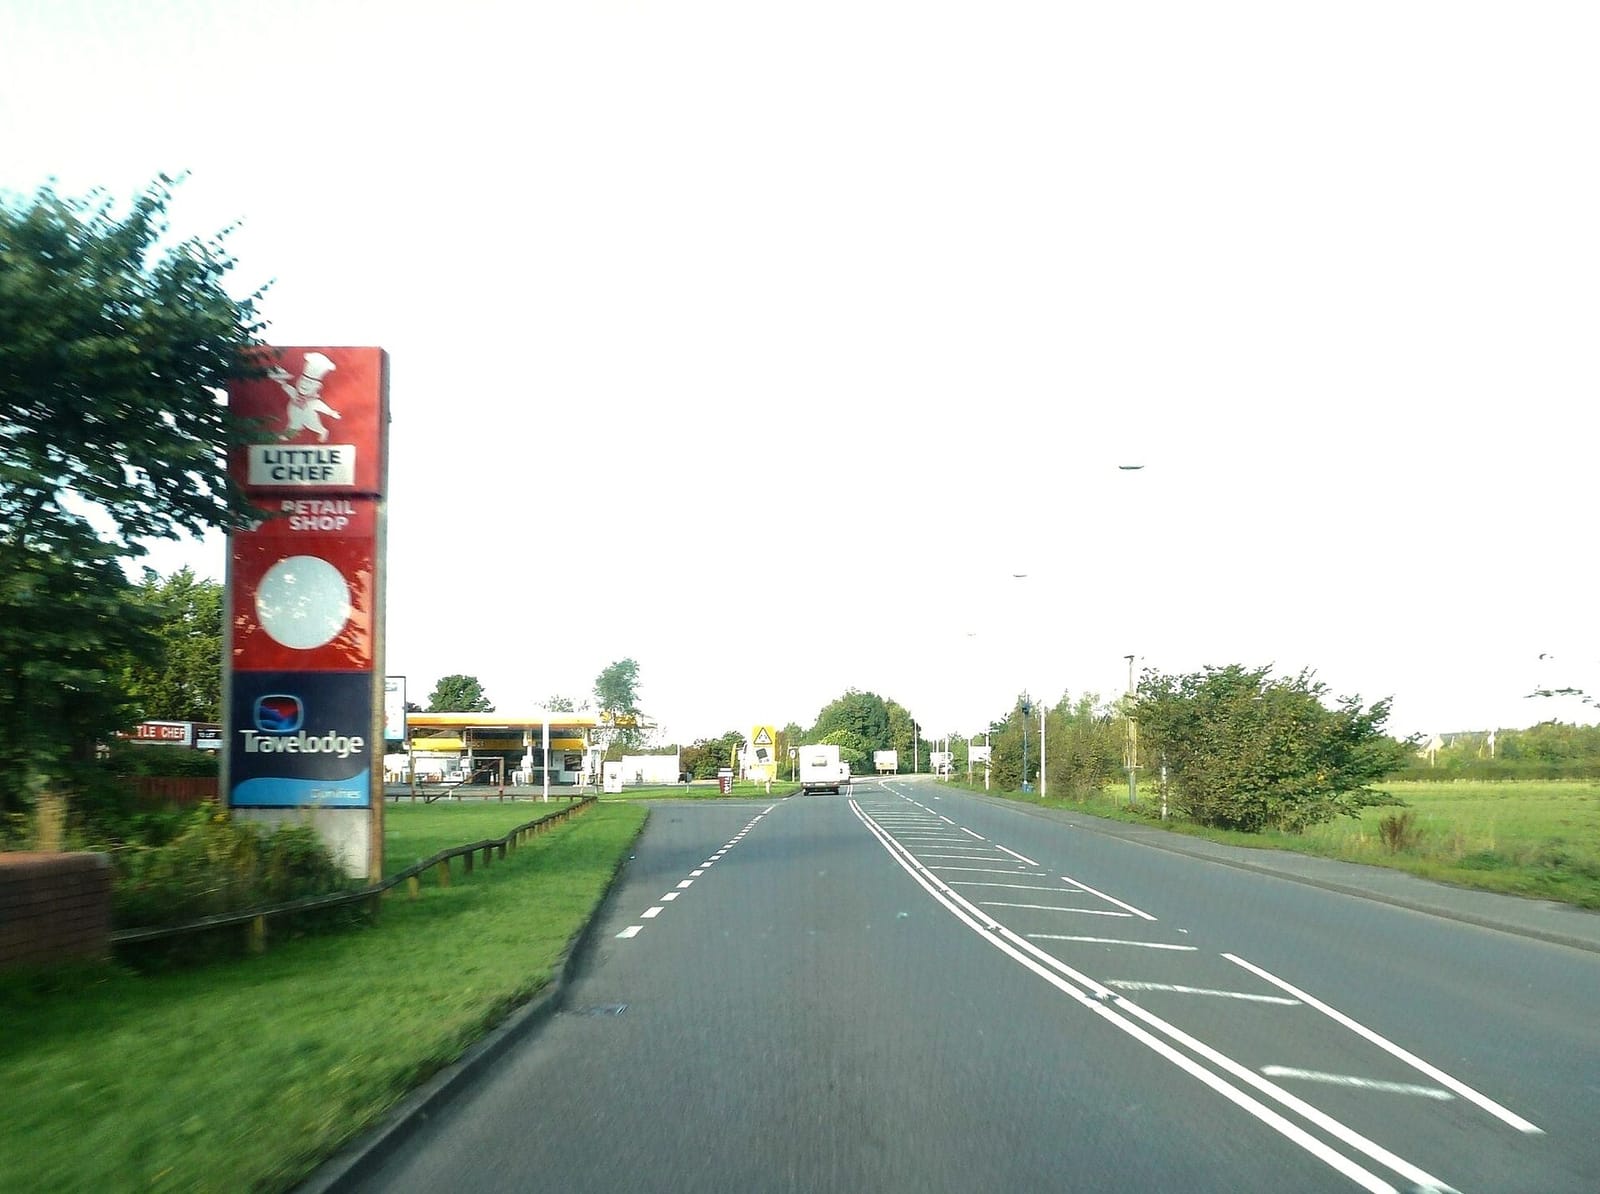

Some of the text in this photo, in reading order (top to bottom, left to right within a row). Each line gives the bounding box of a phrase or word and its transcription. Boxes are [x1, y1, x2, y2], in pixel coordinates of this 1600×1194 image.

[264, 450, 341, 464] LITTLE
[272, 467, 333, 480] CHEF
[289, 515, 348, 530] SHOP
[161, 726, 185, 739] CHEF
[239, 730, 364, 758] Travelodge
